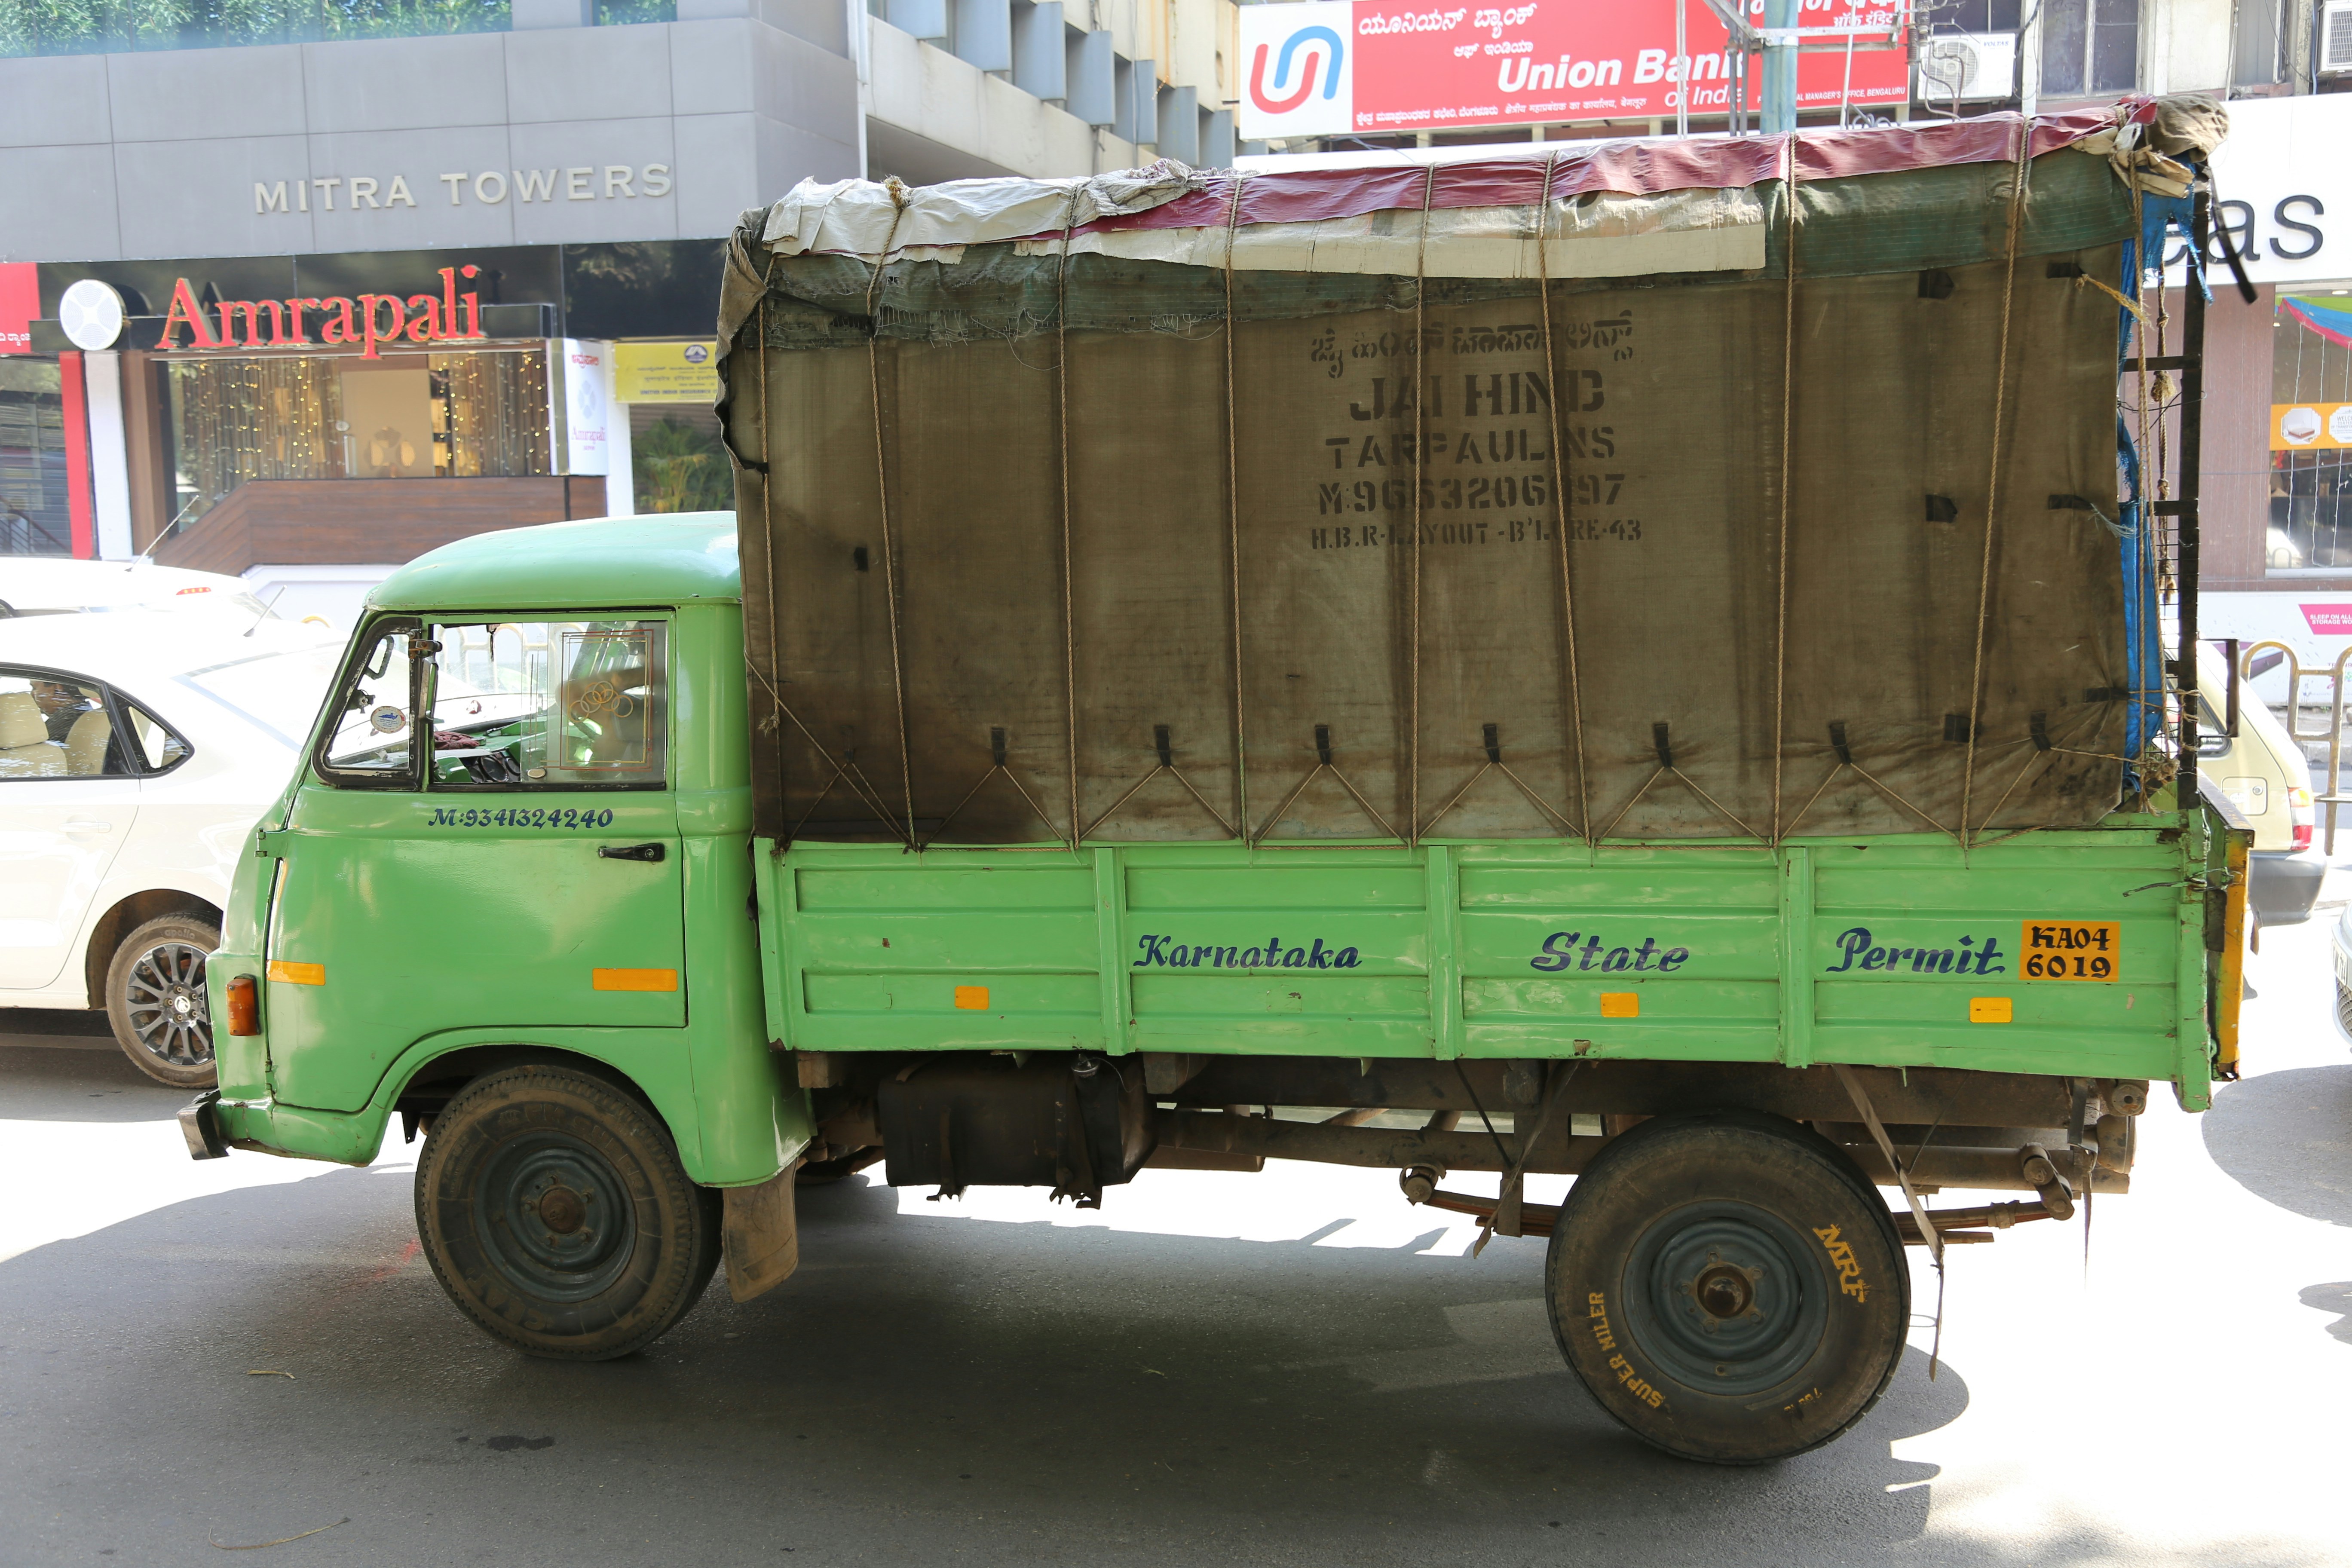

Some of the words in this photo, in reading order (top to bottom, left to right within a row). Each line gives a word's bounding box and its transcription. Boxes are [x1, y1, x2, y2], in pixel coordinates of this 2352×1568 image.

[1498, 55, 1623, 93] Union
[1805, 90, 1841, 101] MANAGER'S
[1867, 86, 1905, 97] BENGALURU
[254, 175, 416, 214] MITRA
[439, 163, 673, 206] TOWERS
[159, 264, 486, 360] Amrapali
[1350, 374, 1443, 421] JAI
[1464, 370, 1605, 417] HIND
[571, 426, 606, 444] Amrapali
[1326, 426, 1615, 469] TARPAULINS
[164, 928, 195, 939] apollo
[1133, 934, 1364, 971] Karnataka
[1530, 931, 1690, 972] State
[1825, 927, 2006, 975] Permit
[2030, 925, 2111, 952] KA04
[2026, 953, 2112, 979] 6019
[1813, 1224, 1866, 1303] MRF
[1587, 1292, 1616, 1351] MILER
[1609, 1353, 1666, 1409] SUPER
